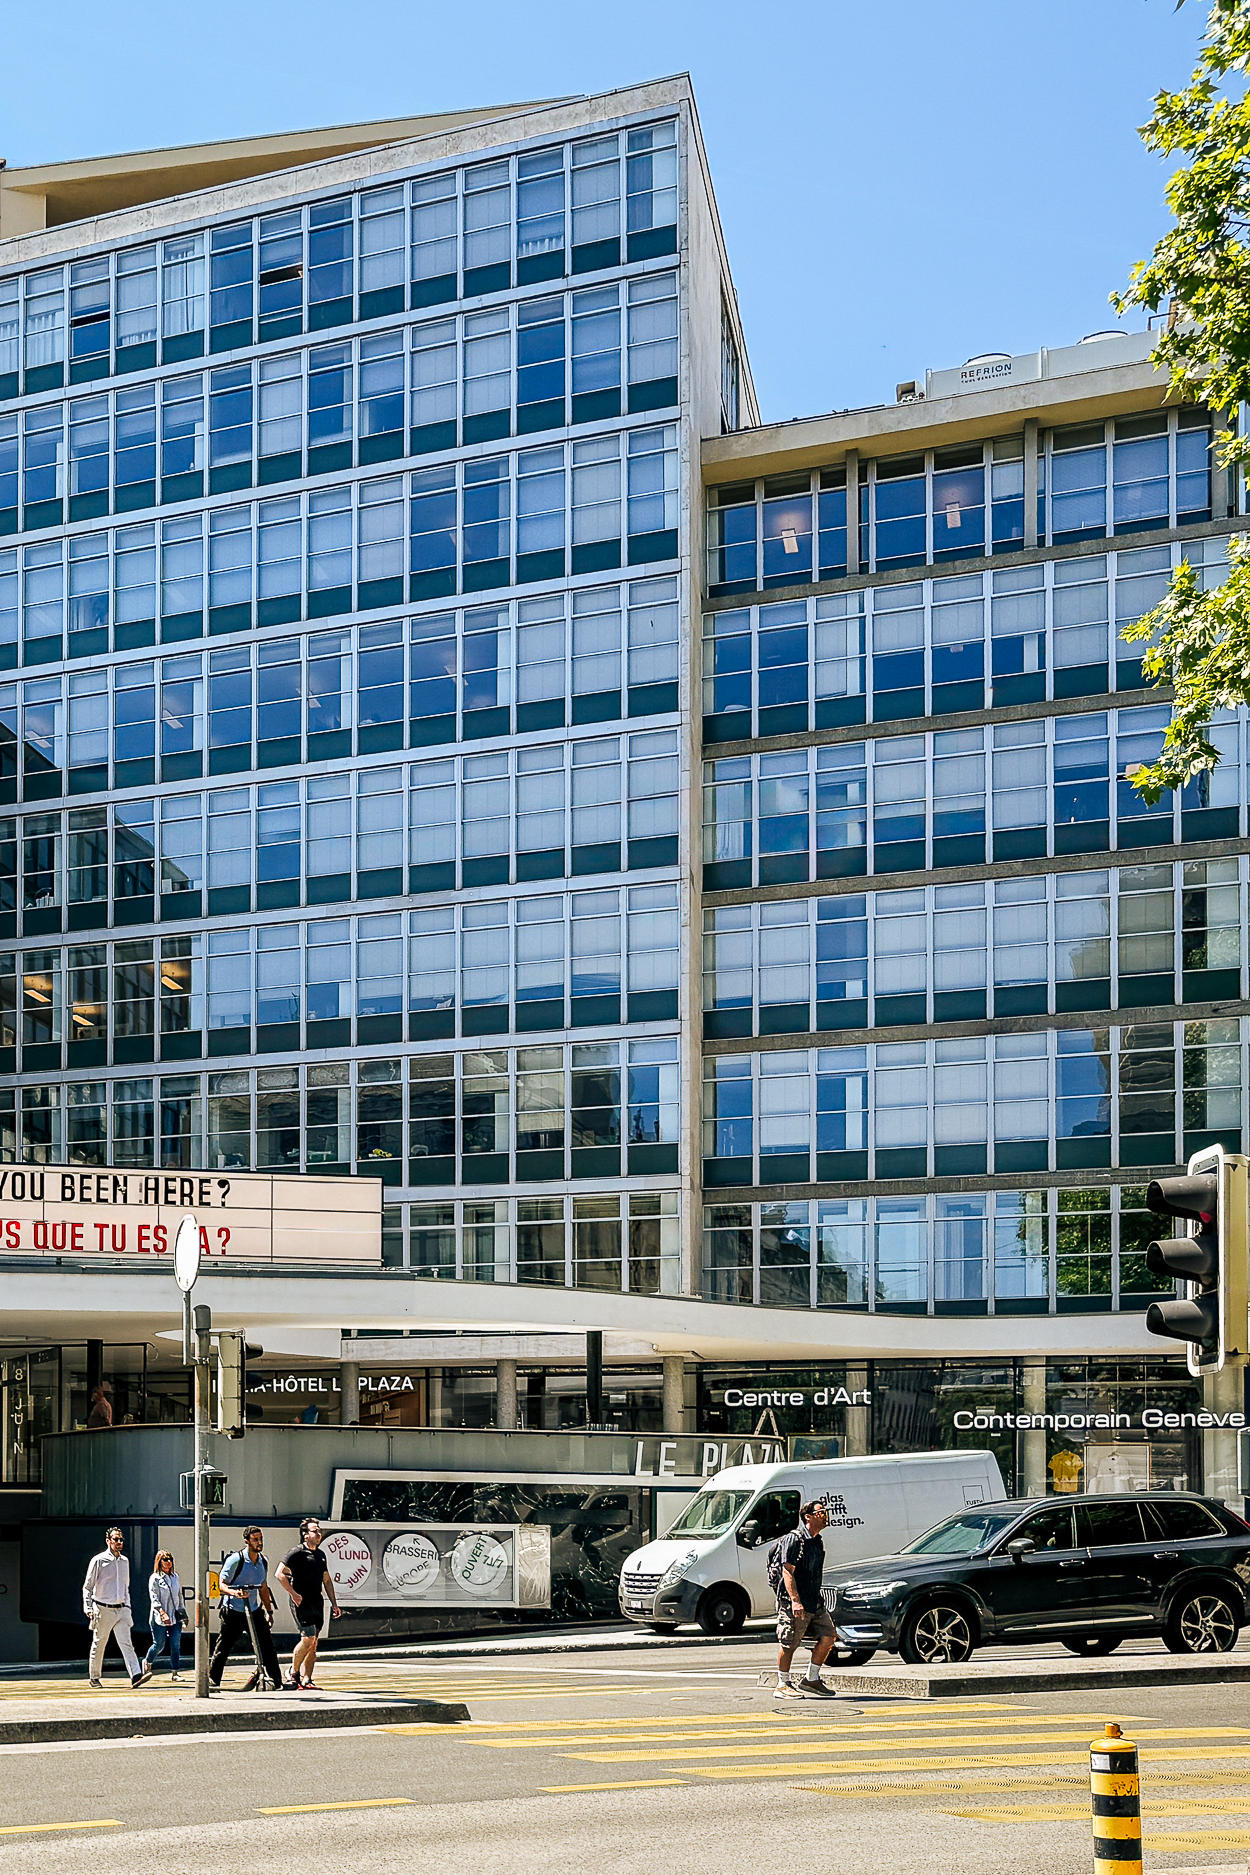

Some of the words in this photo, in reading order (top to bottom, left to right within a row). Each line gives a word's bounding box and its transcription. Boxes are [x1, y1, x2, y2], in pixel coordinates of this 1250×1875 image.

[961, 363, 1012, 379] REFRION
[61, 1173, 128, 1204] BEEN
[144, 1176, 231, 1207] HERE?
[33, 1221, 84, 1251] QUE
[93, 1223, 127, 1252] TU
[137, 1225, 168, 1254] ES
[358, 1376, 414, 1391] PLAZA
[724, 1388, 804, 1407] Centre
[813, 1387, 872, 1406] d'Art
[952, 1409, 1131, 1432] Contemporain
[1141, 1407, 1246, 1428] Genève
[635, 1441, 677, 1477] LE
[819, 1491, 844, 1506] glas
[328, 1535, 350, 1553] DÈS
[461, 1536, 487, 1579] OUVERT
[333, 1572, 342, 1583] 8
[347, 1564, 369, 1588] JUIN
